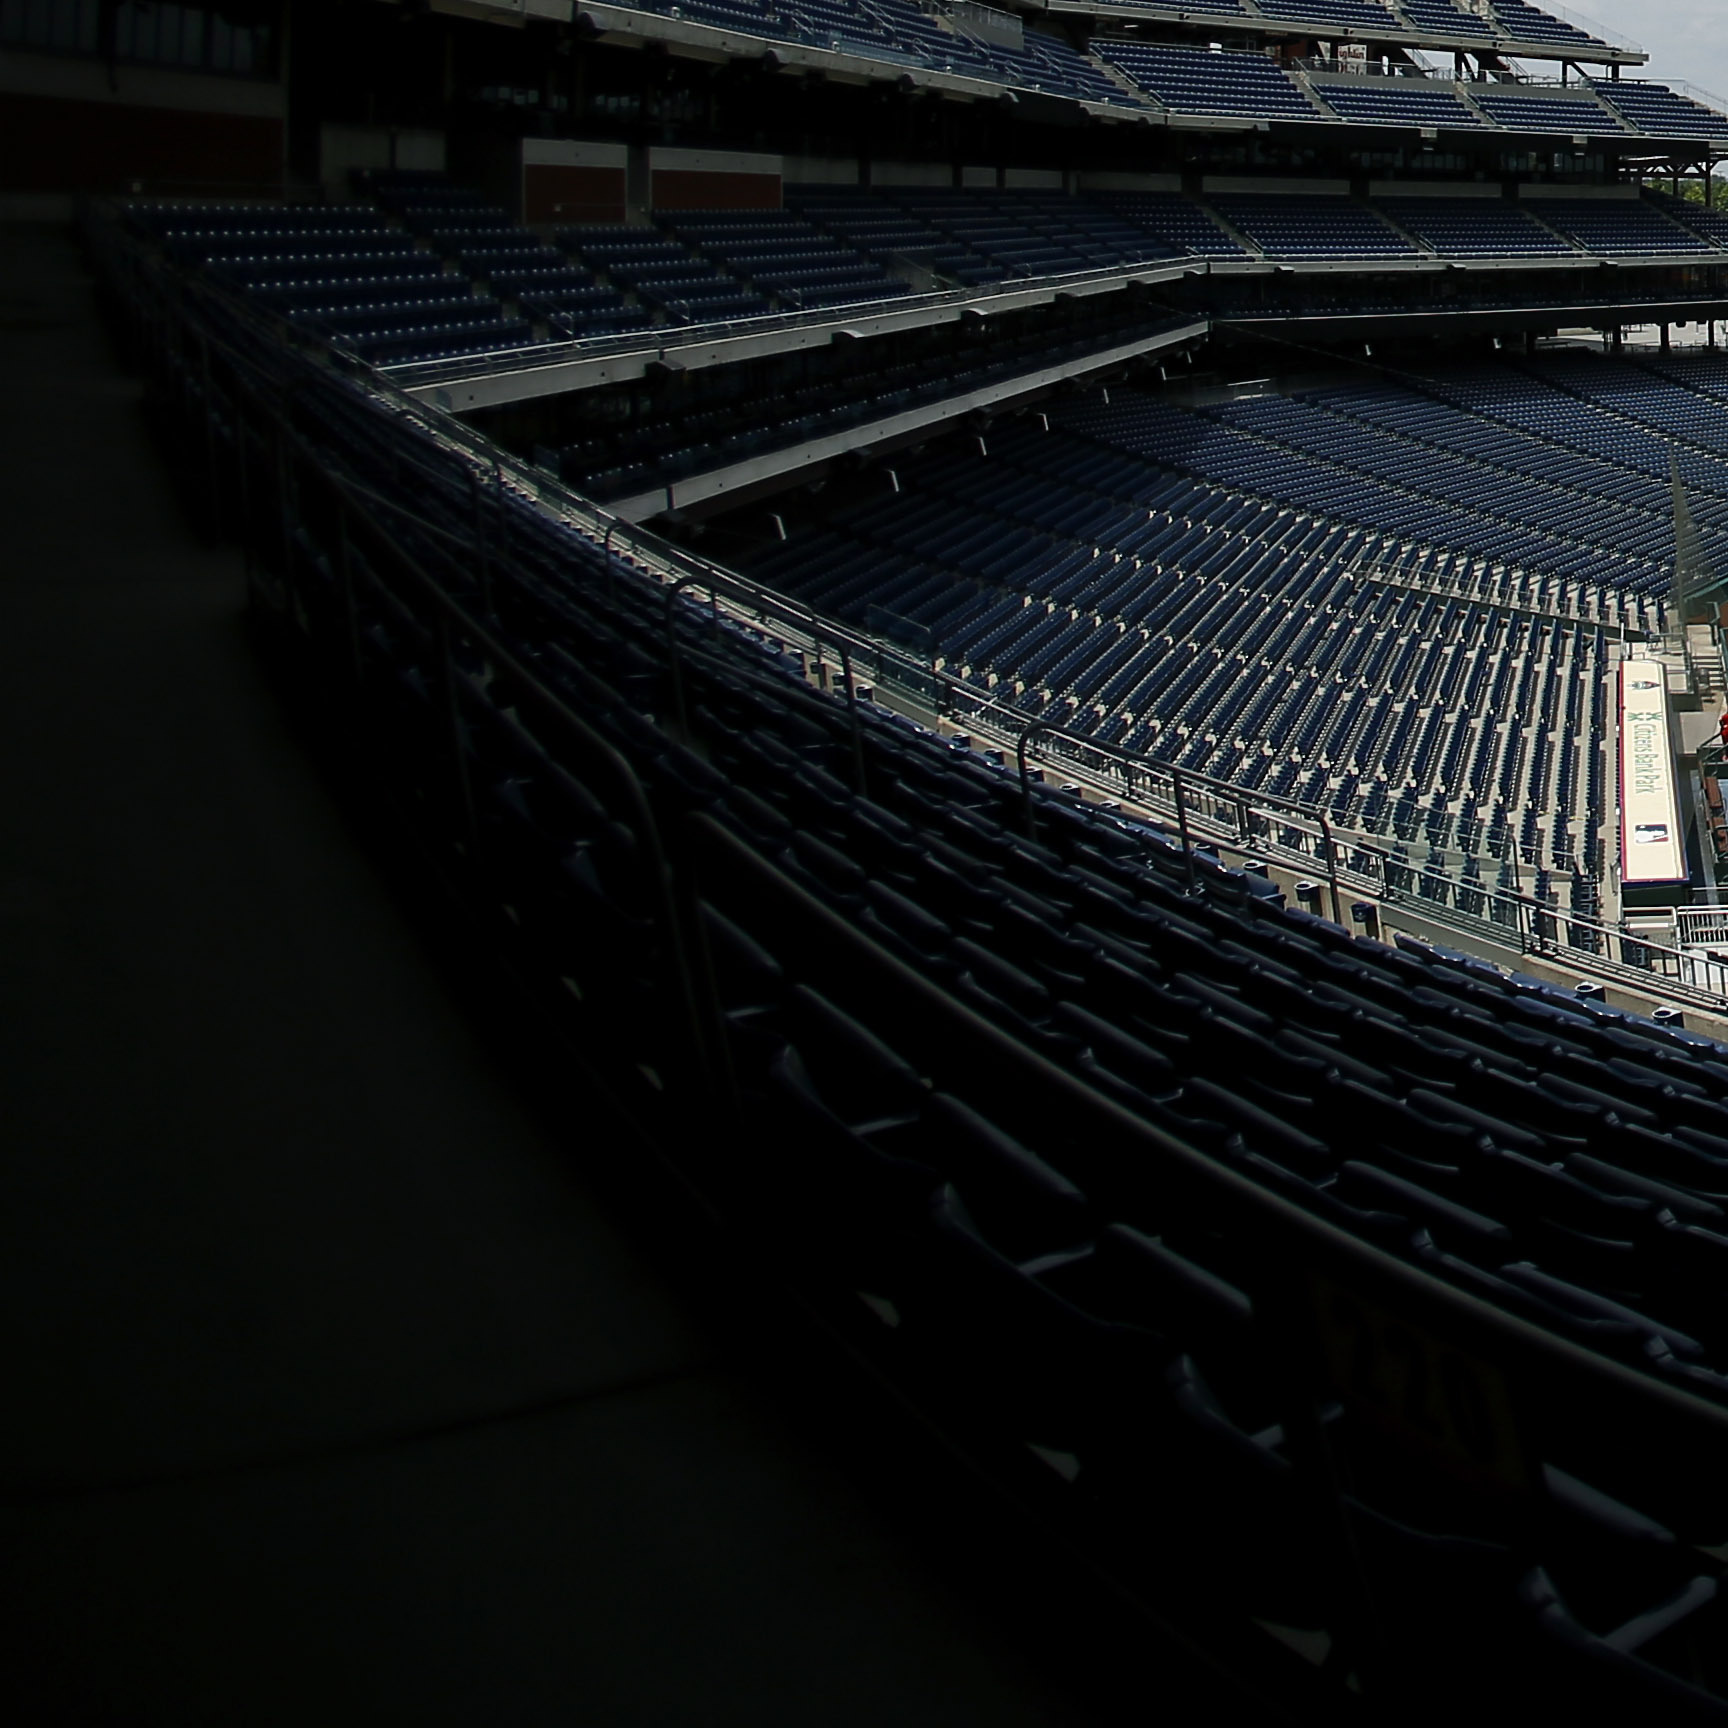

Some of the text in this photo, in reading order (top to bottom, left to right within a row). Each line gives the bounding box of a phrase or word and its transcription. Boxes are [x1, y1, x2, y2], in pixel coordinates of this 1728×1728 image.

[1634, 723, 1664, 794] Citizens Bank Park
